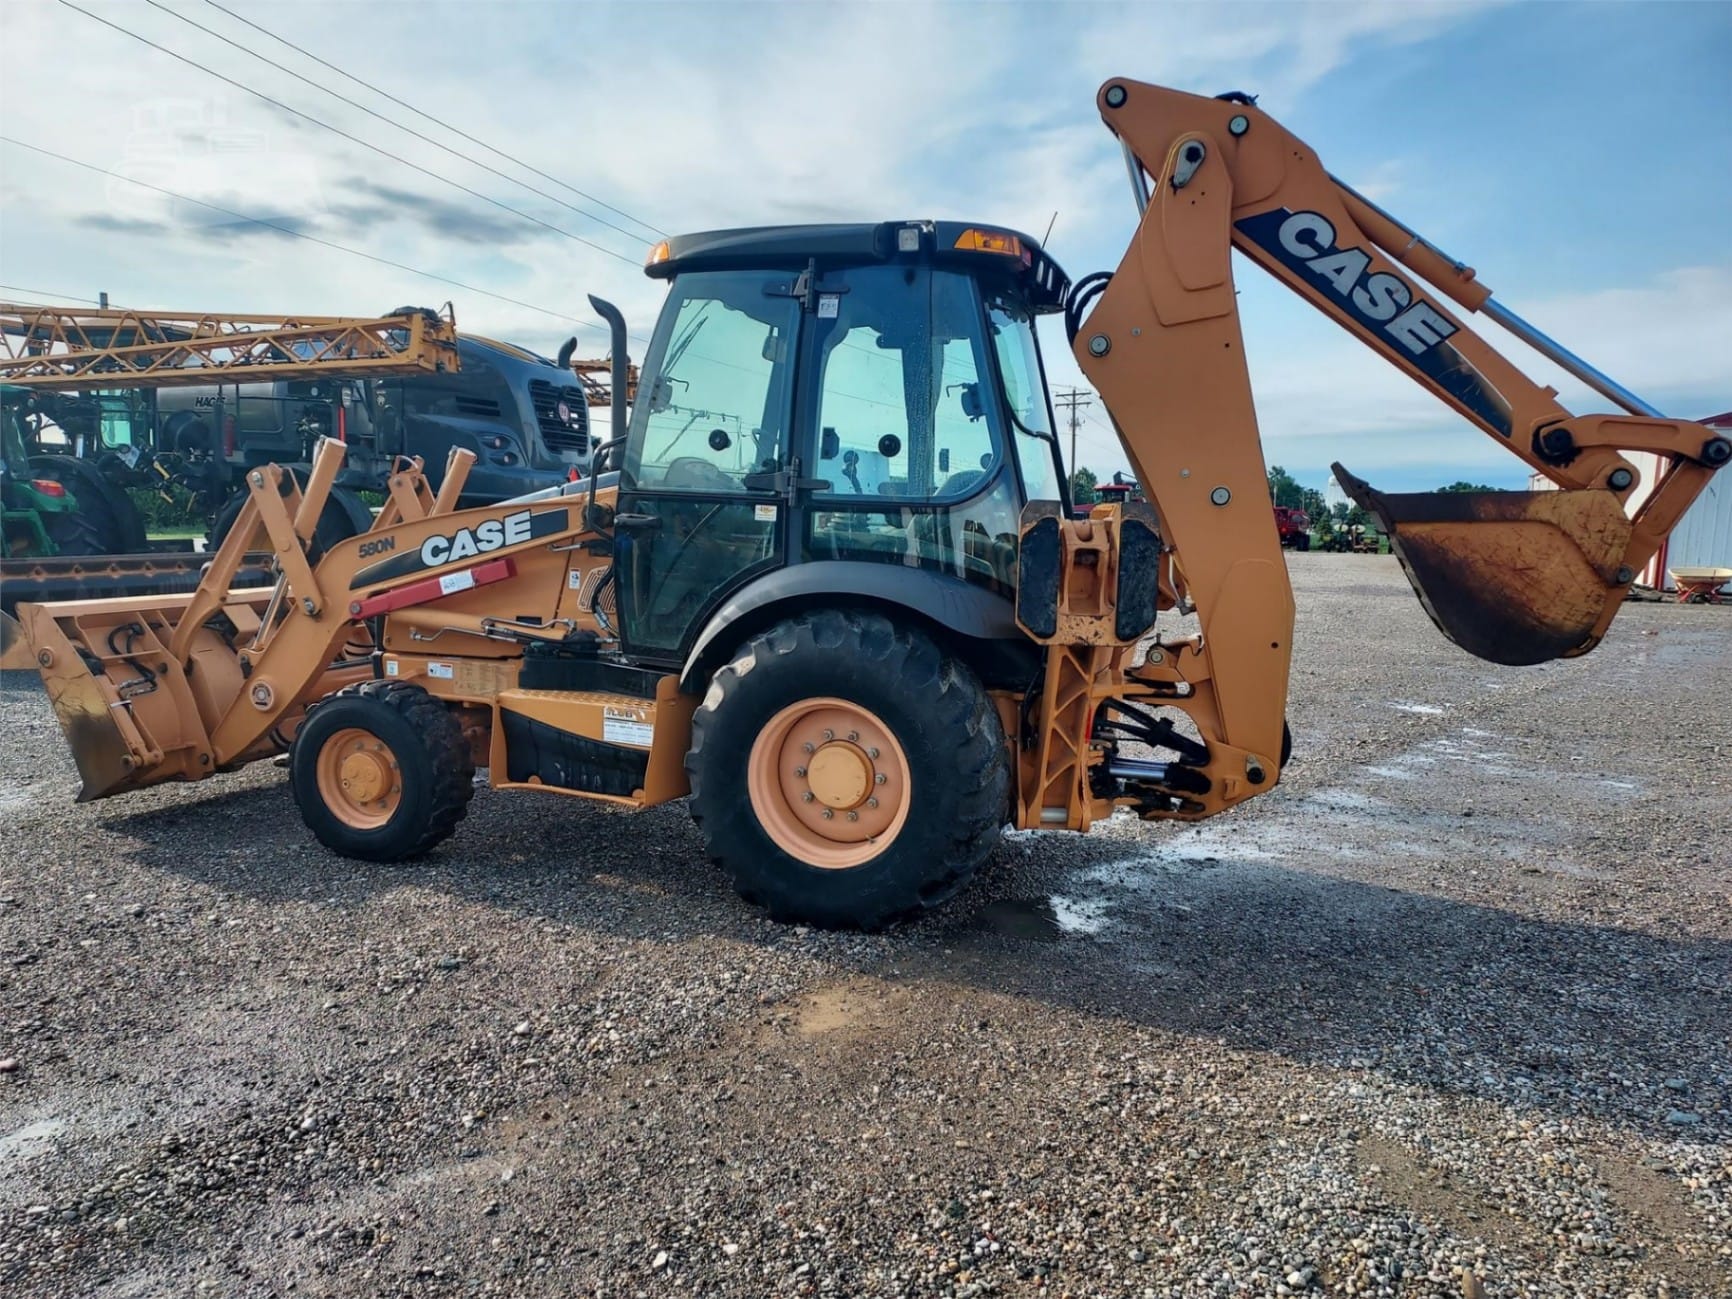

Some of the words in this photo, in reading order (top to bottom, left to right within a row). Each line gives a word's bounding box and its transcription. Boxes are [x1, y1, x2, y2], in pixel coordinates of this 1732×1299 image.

[1278, 212, 1459, 355] CASE
[358, 536, 395, 558] 580N
[421, 510, 531, 566] CASE
